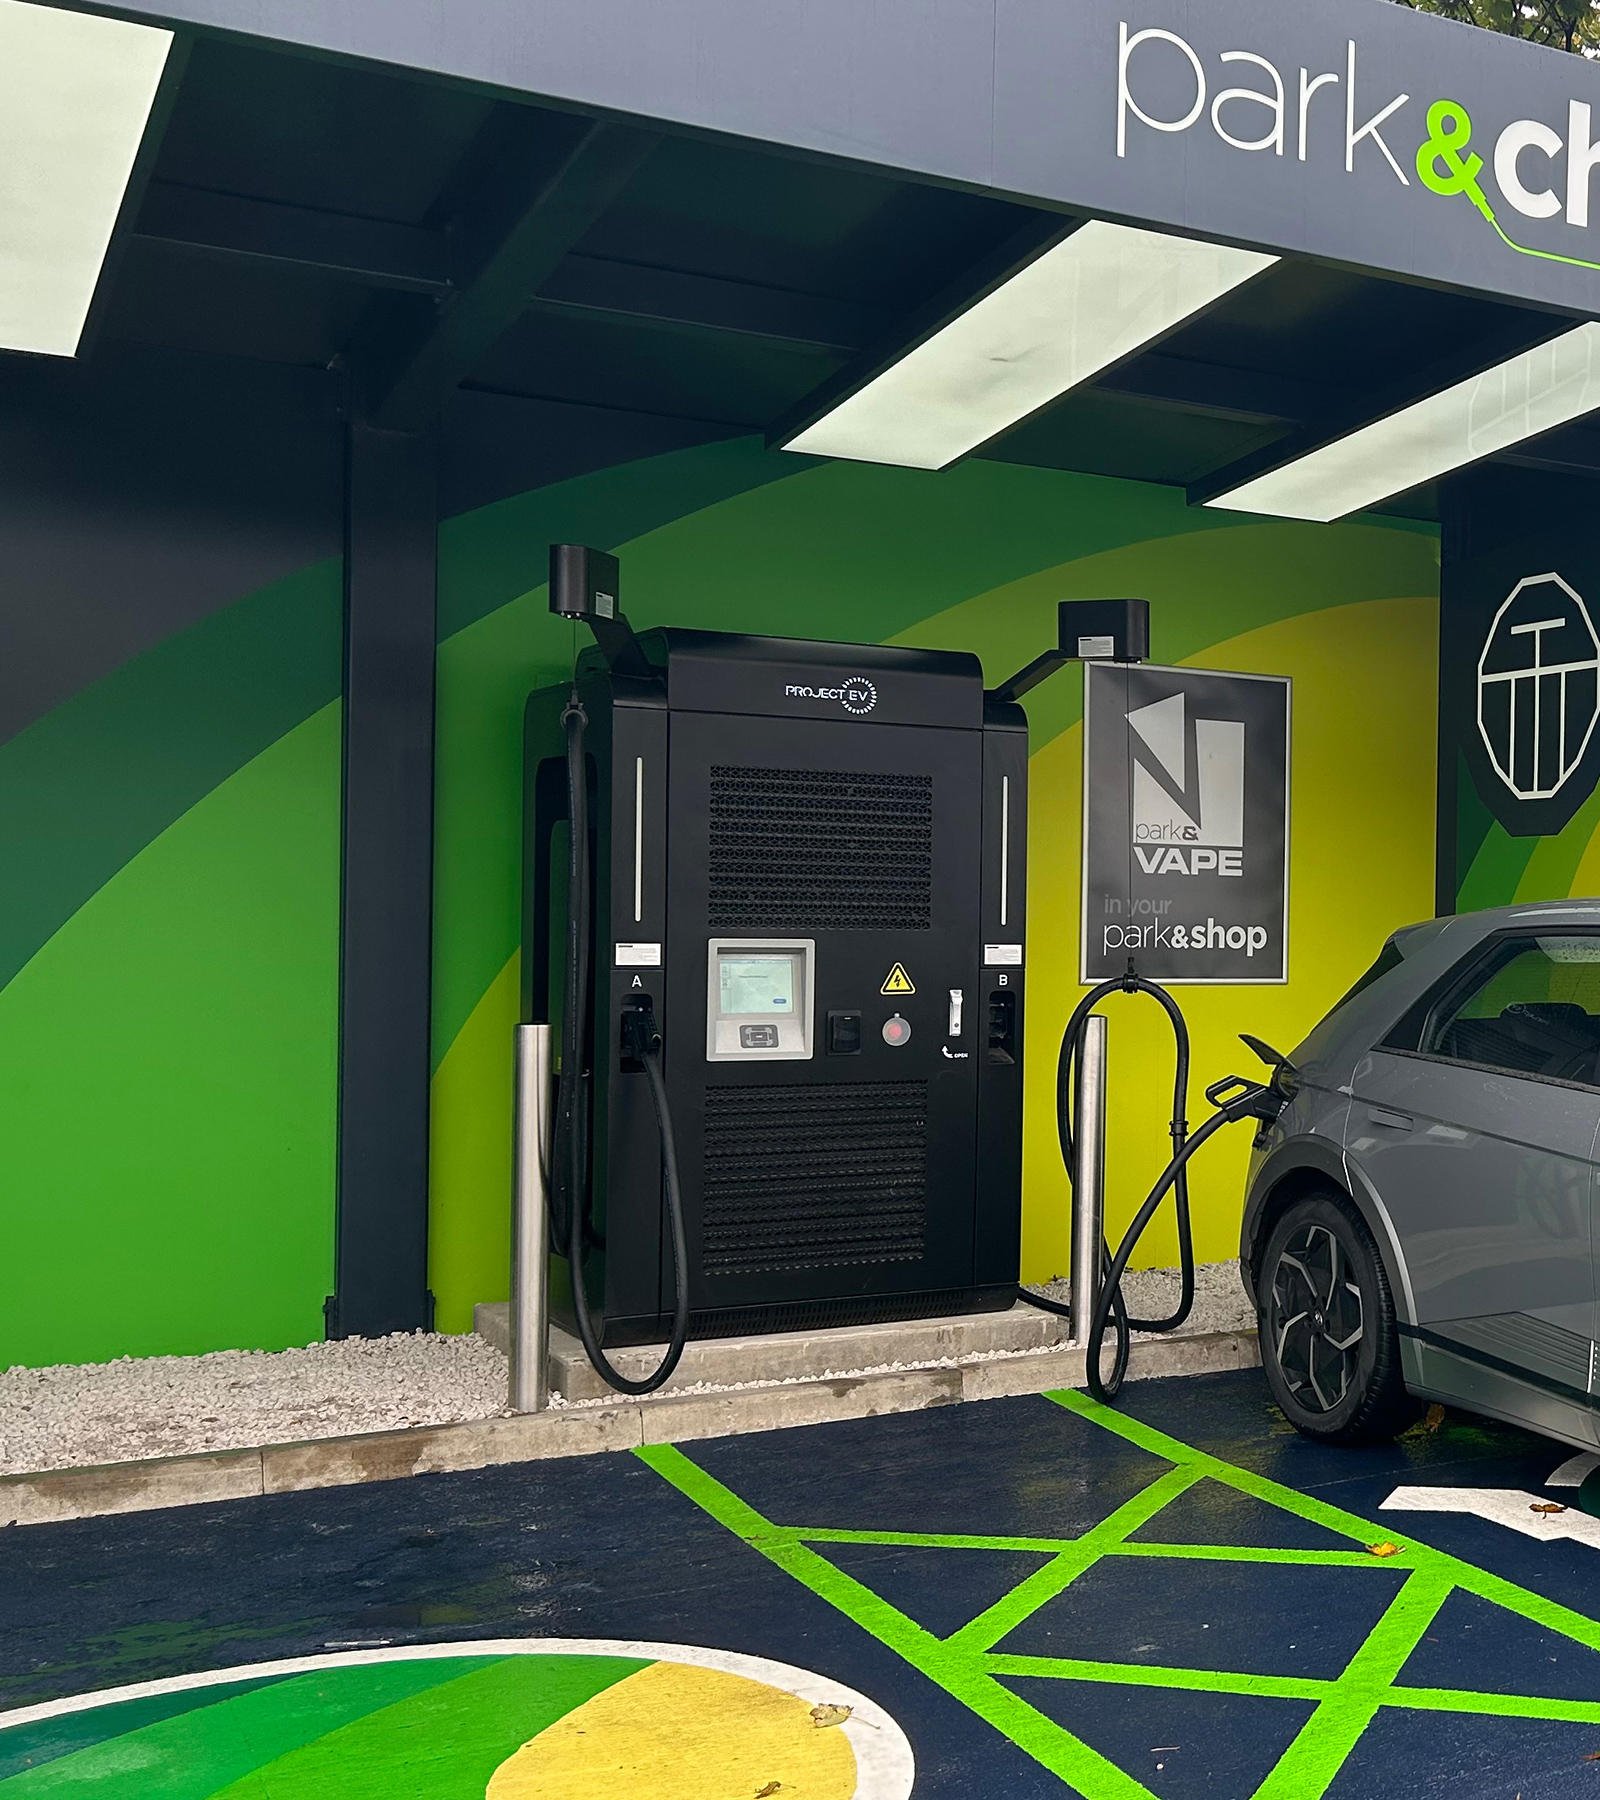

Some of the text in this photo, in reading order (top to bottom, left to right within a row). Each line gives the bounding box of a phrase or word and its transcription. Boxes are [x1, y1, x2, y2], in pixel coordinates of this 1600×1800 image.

[785, 685, 868, 701] PROJECT EV
[1136, 819, 1199, 843] park&
[1133, 847, 1243, 876] VAPE
[1104, 894, 1172, 917] in your
[1103, 917, 1268, 957] park&shop
[631, 974, 643, 988] A
[999, 974, 1008, 985] B
